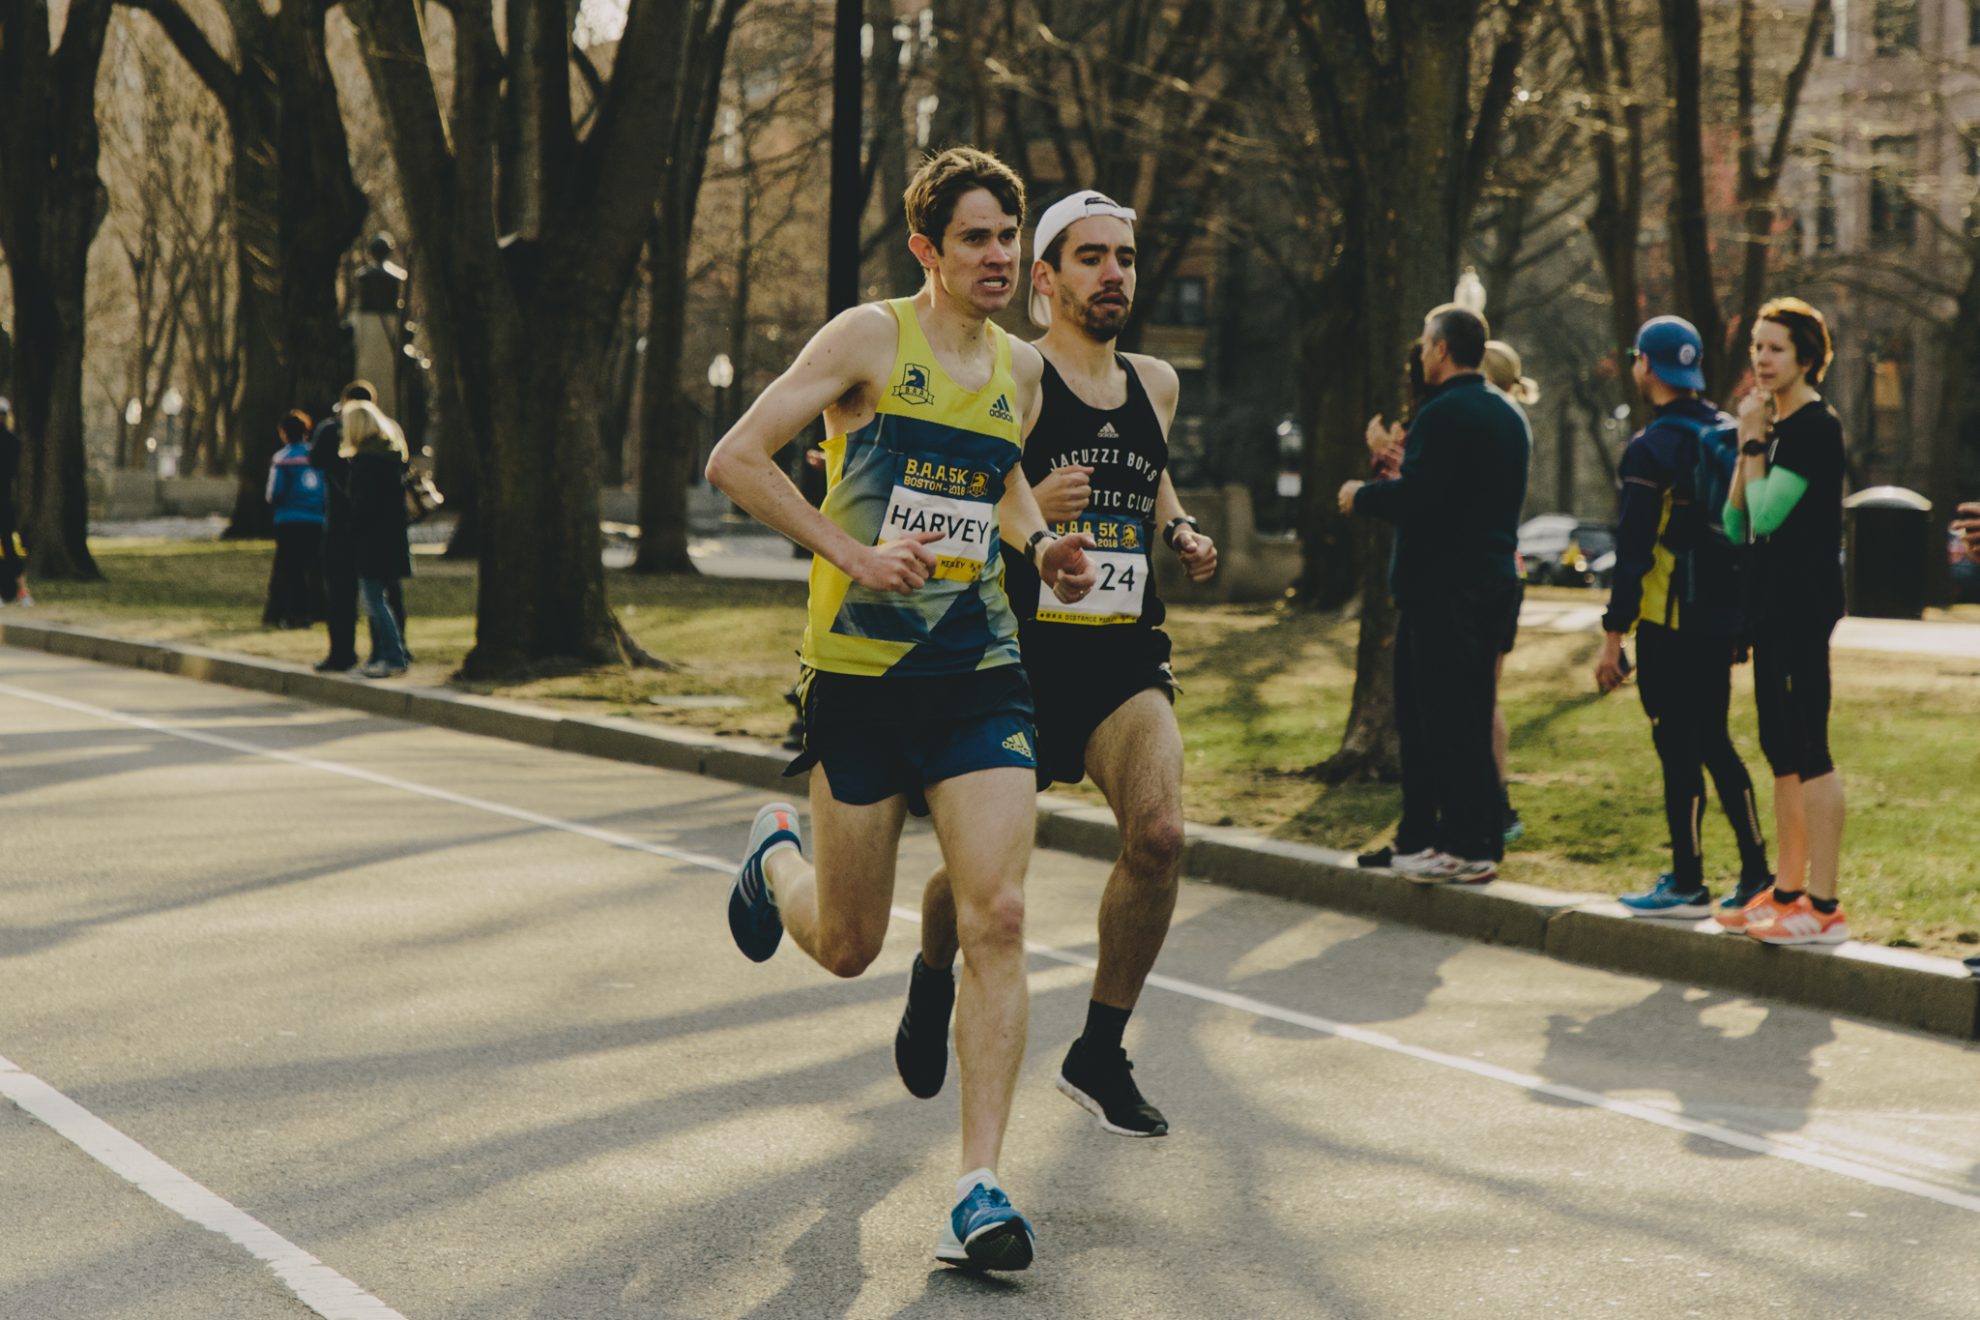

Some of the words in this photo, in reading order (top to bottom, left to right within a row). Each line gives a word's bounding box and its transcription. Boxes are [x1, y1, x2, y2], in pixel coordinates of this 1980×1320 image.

[1050, 448, 1120, 472] JACUZZI
[1127, 452, 1157, 482] BOYS
[1093, 490, 1121, 507] TIC
[890, 504, 989, 545] HARVEY
[1098, 563, 1135, 591] 24
